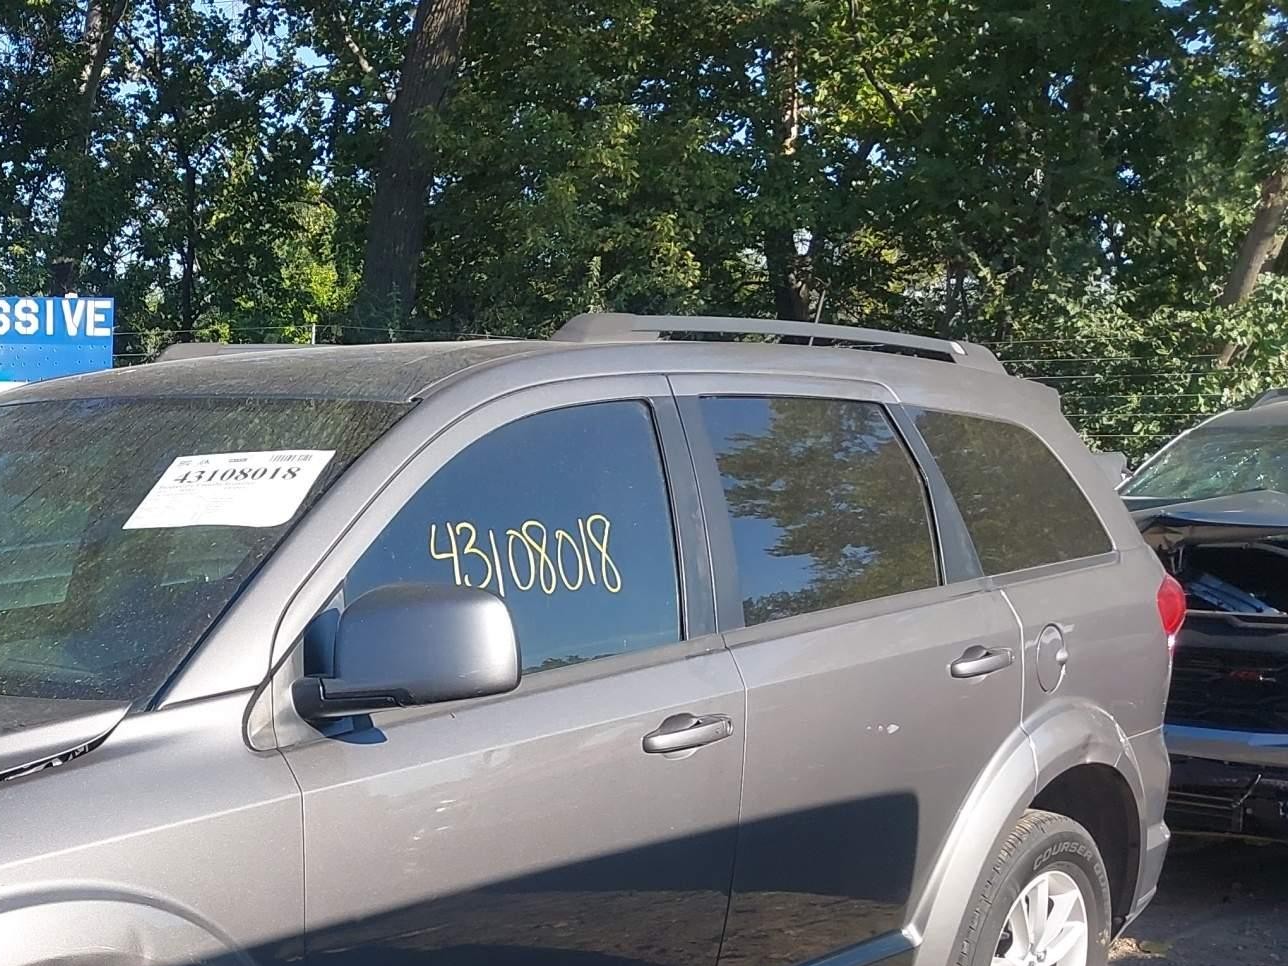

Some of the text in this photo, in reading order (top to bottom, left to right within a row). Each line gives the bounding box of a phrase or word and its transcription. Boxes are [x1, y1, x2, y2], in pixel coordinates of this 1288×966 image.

[173, 466, 301, 484] 43108018
[429, 513, 622, 597] 43108018
[1033, 841, 1093, 871] COURSER
